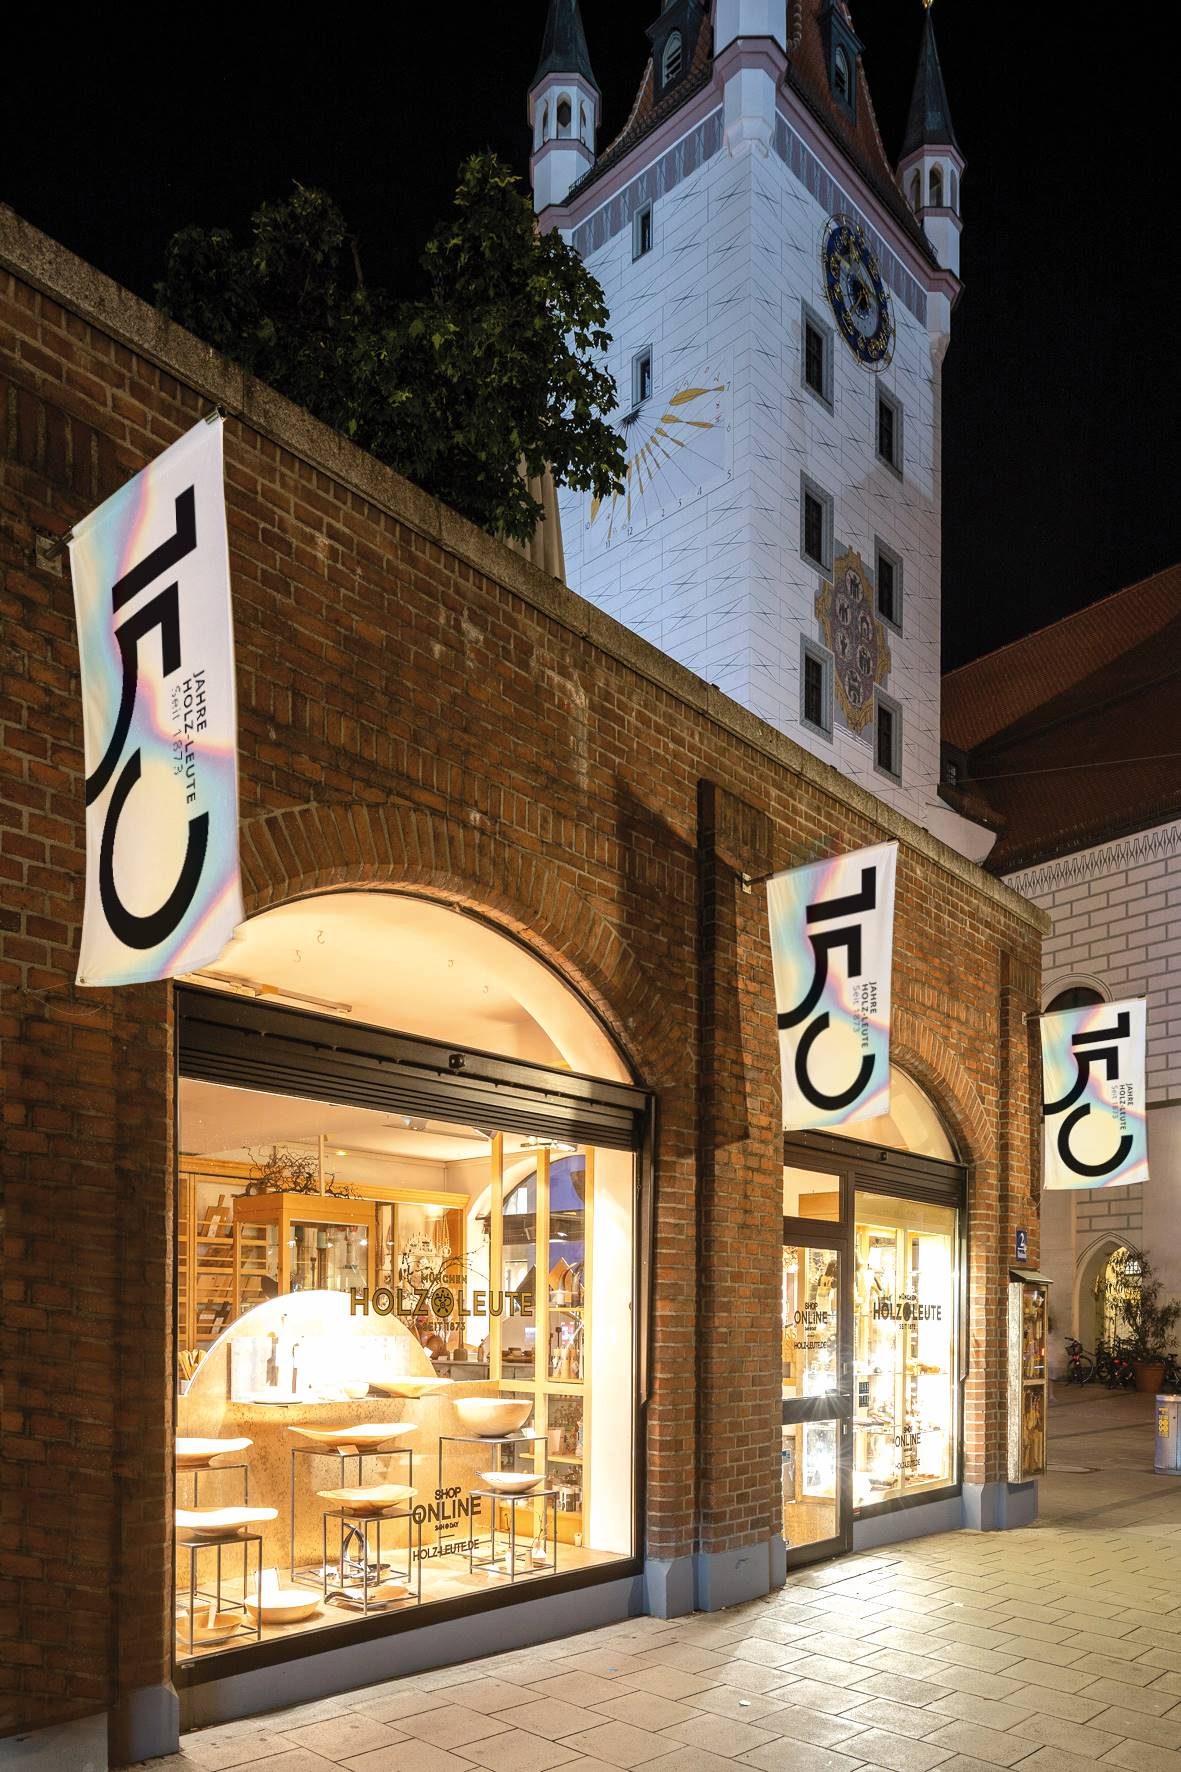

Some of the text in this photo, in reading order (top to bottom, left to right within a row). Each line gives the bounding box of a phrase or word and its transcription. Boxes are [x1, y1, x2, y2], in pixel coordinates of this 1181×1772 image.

[193, 670, 207, 733] JAHRE
[173, 729, 183, 776] 1873
[183, 678, 196, 804] HOLZ-LEUTE
[869, 981, 877, 1014] JAHRE
[1126, 1083, 1134, 1106] JAHRE
[458, 1290, 533, 1317] LEUTE
[805, 1302, 818, 1310] SHOP
[912, 1304, 941, 1320] LEUTE
[422, 1322, 441, 1331] SEIT
[794, 1310, 828, 1324] ONLINE
[895, 1433, 921, 1447] ONLINE
[434, 1486, 462, 1500] SHOP
[412, 1496, 482, 1525] ONLINE
